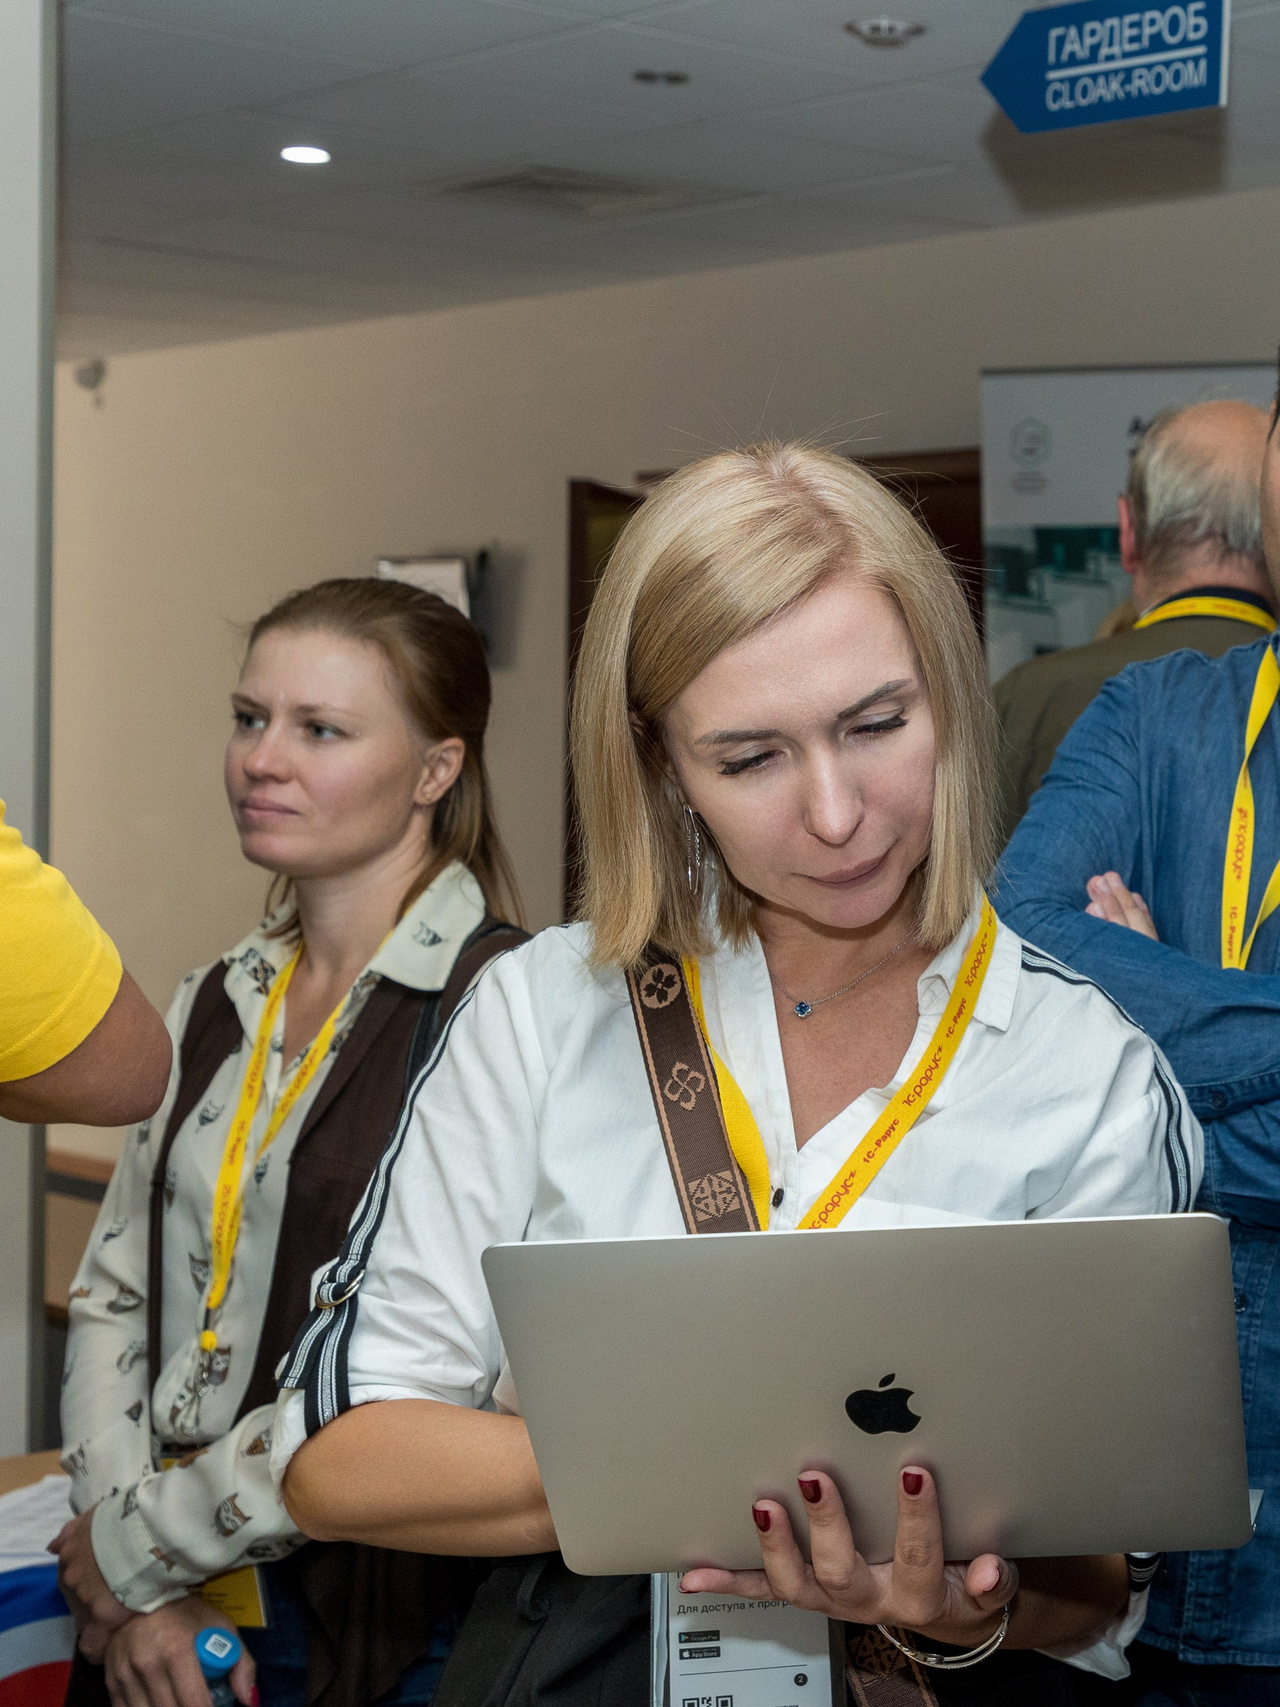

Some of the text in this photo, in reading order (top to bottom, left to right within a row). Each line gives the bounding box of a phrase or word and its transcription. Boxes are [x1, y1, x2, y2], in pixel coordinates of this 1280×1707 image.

[1048, 2, 1208, 64] ГАРДЕРОБ
[1045, 57, 1207, 111] CLOAK-ROOM
[862, 1118, 900, 1164] 1С-Рарус
[677, 1599, 792, 1615] Для доступа к прогр
